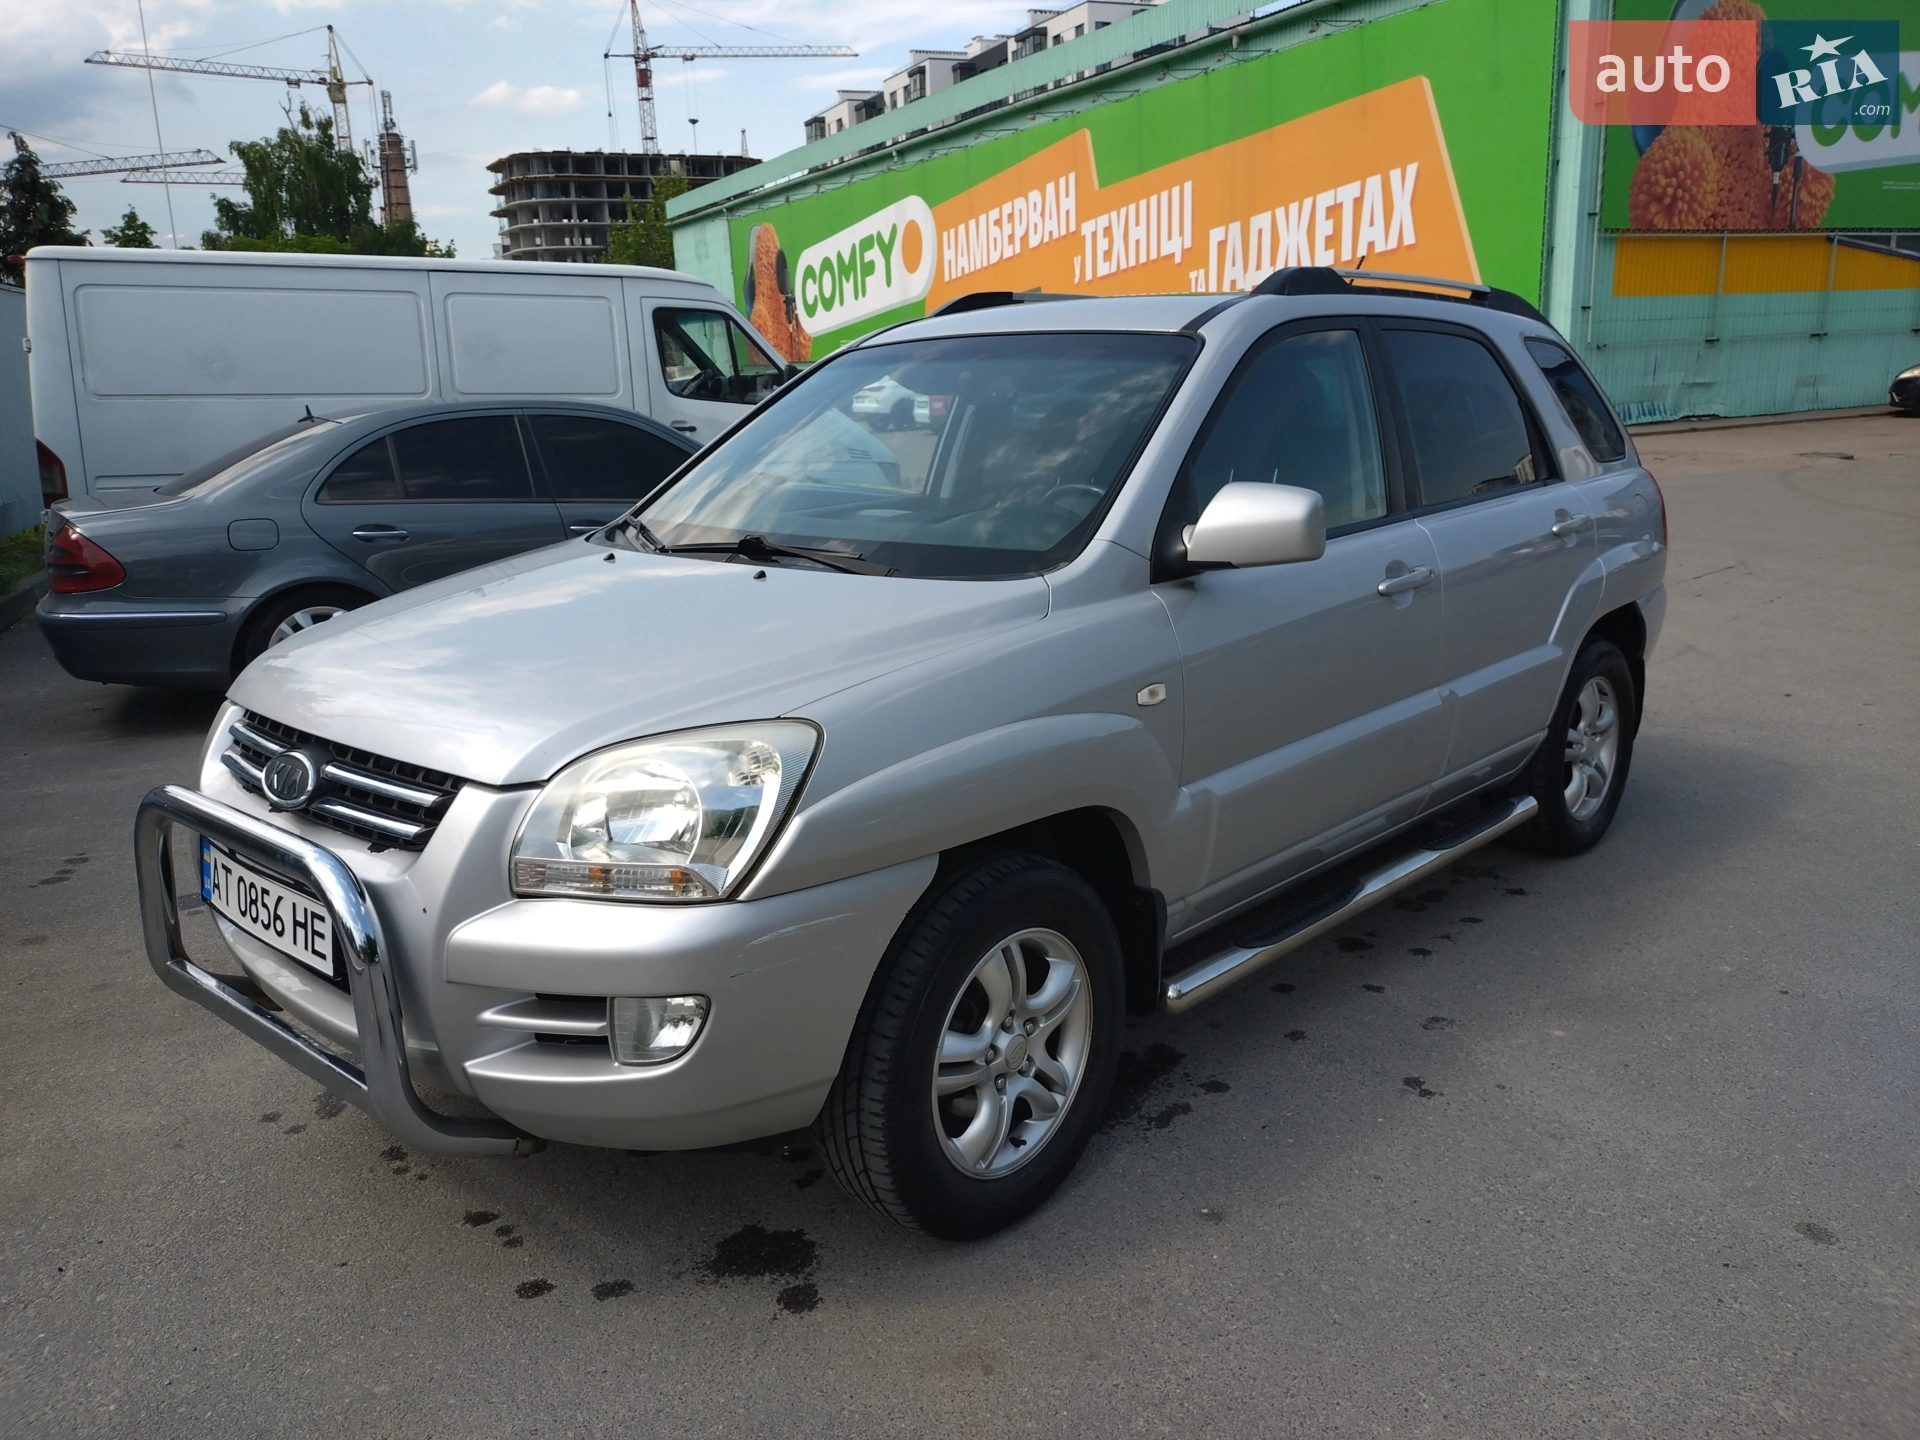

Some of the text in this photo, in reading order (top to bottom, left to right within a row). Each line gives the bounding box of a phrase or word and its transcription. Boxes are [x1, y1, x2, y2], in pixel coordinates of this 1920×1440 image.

[801, 222, 898, 319] COMFY
[942, 171, 1076, 283] НАМБЕРВАН
[1081, 180, 1193, 282] ТЕХНІЦІ
[1208, 161, 1419, 293] ГАДЖЕТАХ
[212, 857, 327, 961] AT 0856 HE
